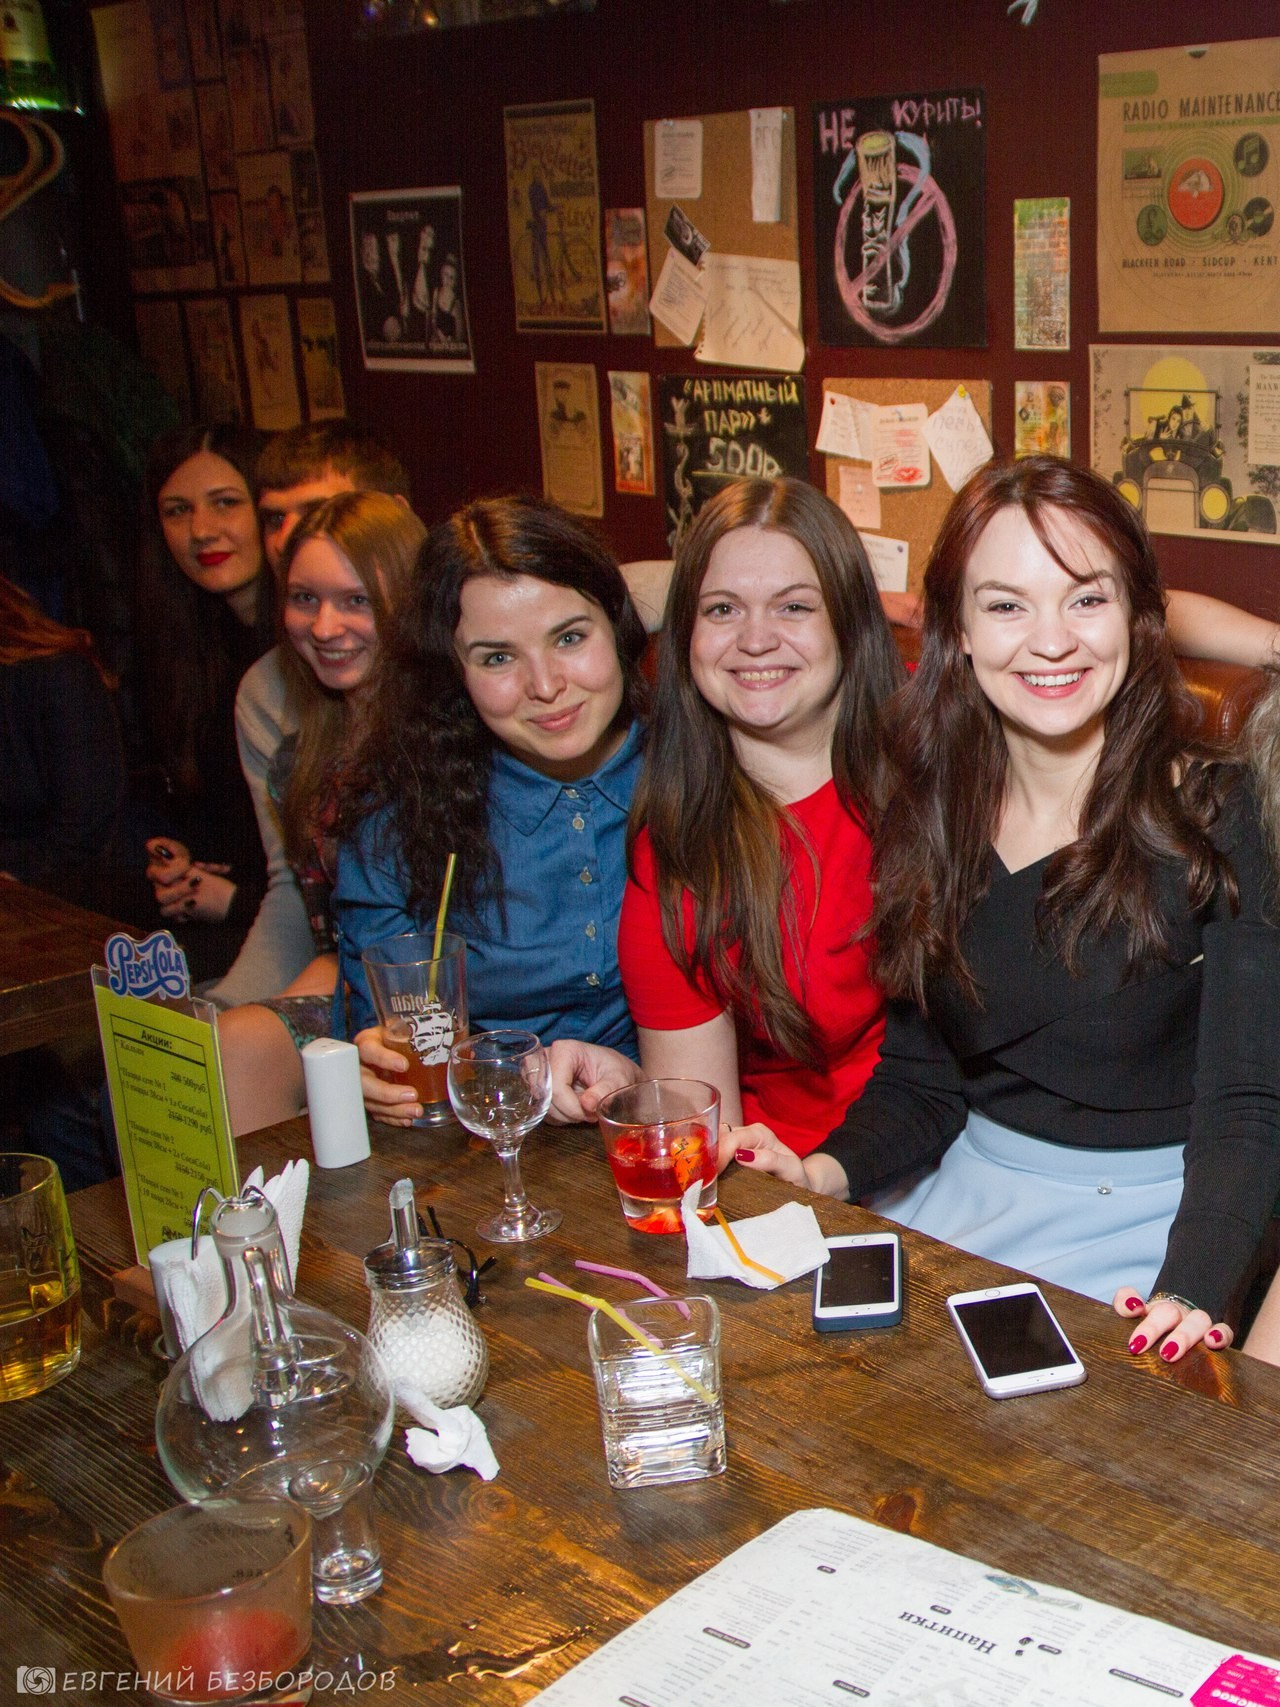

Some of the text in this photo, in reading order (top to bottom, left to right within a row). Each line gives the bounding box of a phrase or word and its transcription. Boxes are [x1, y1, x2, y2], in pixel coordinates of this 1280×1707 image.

[1123, 99, 1169, 122] RADIO
[819, 97, 983, 154] НЕ КУРИТЬ!
[1164, 257, 1186, 268] ROAD
[1202, 256, 1236, 268] SIDCUP
[1254, 255, 1278, 266] KENT
[141, 1030, 172, 1049] Акции:
[898, 1611, 998, 1655] Напитки
